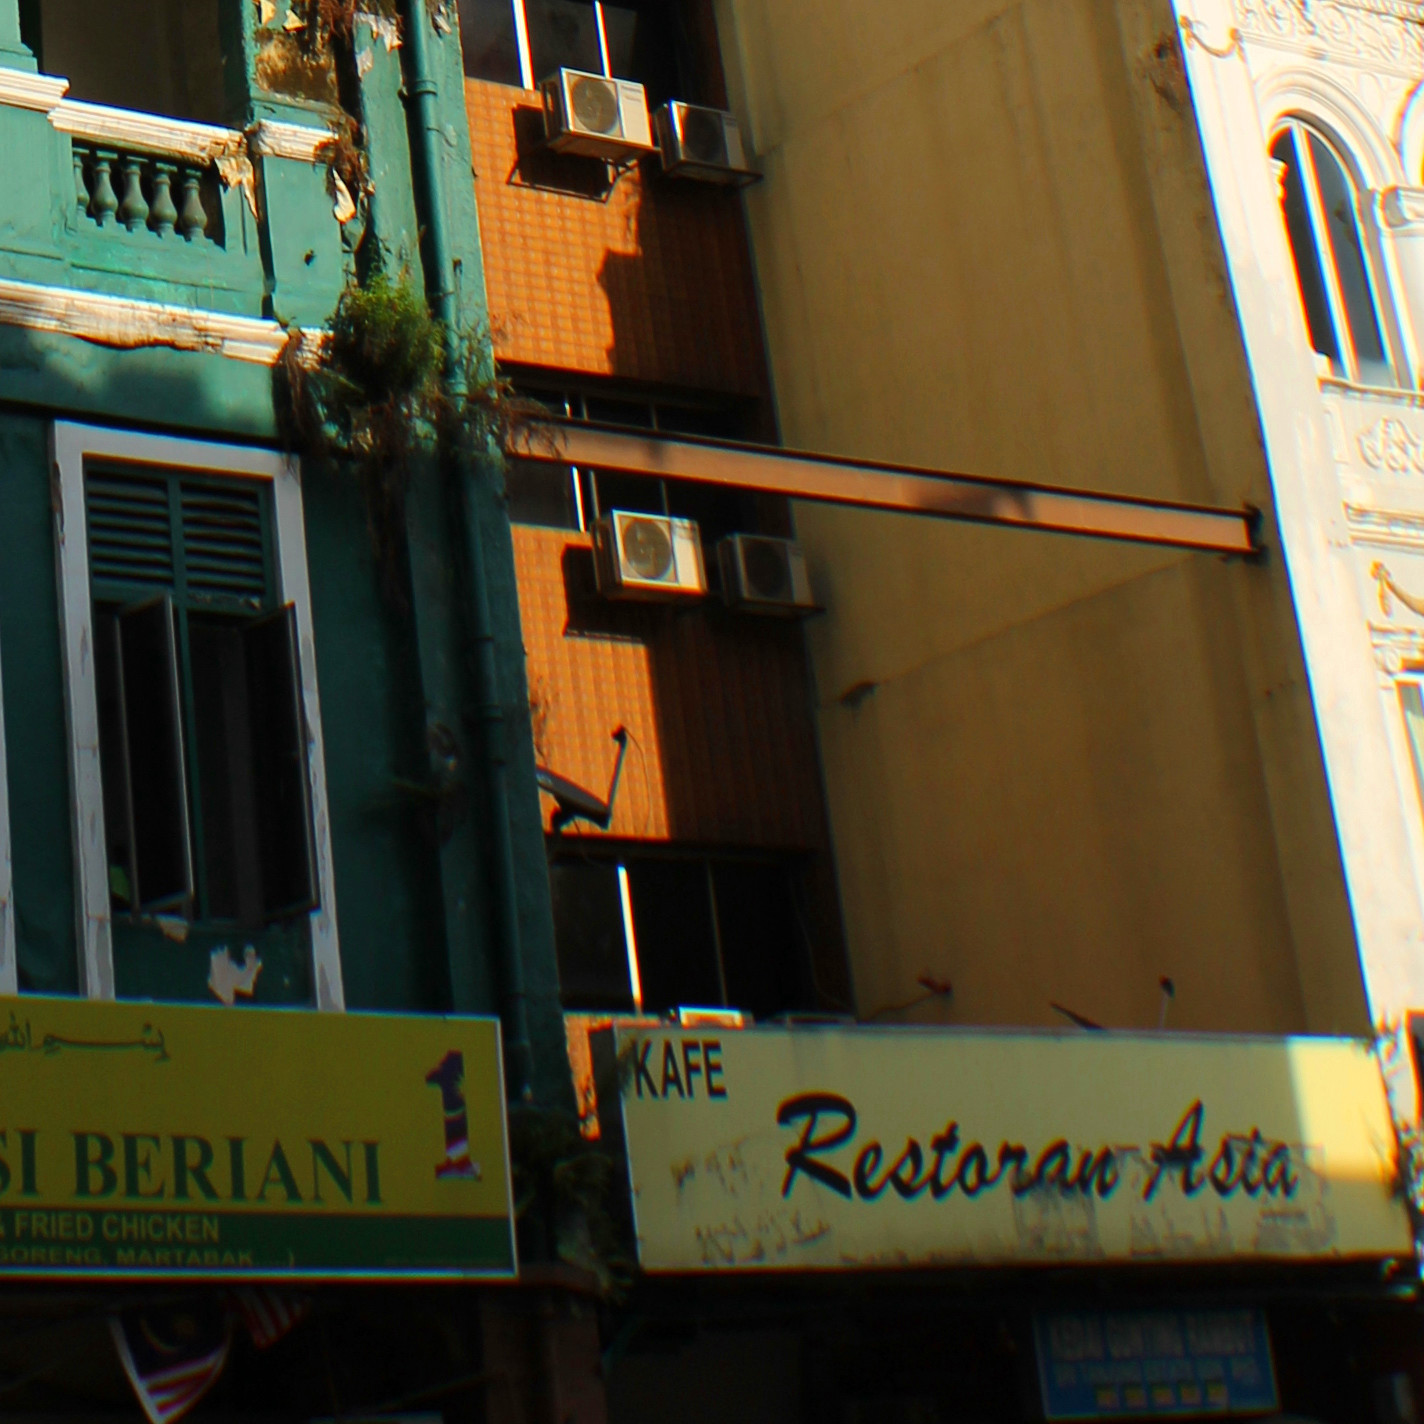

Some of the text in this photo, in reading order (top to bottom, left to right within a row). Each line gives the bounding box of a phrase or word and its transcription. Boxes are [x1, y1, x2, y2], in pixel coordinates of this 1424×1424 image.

[633, 1039, 728, 1100] KAFE
[72, 1131, 386, 1205] BERIANI
[776, 1090, 1121, 1203] Restoran
[14, 1212, 96, 1242] FRIED
[101, 1214, 220, 1244] CHICKEN
